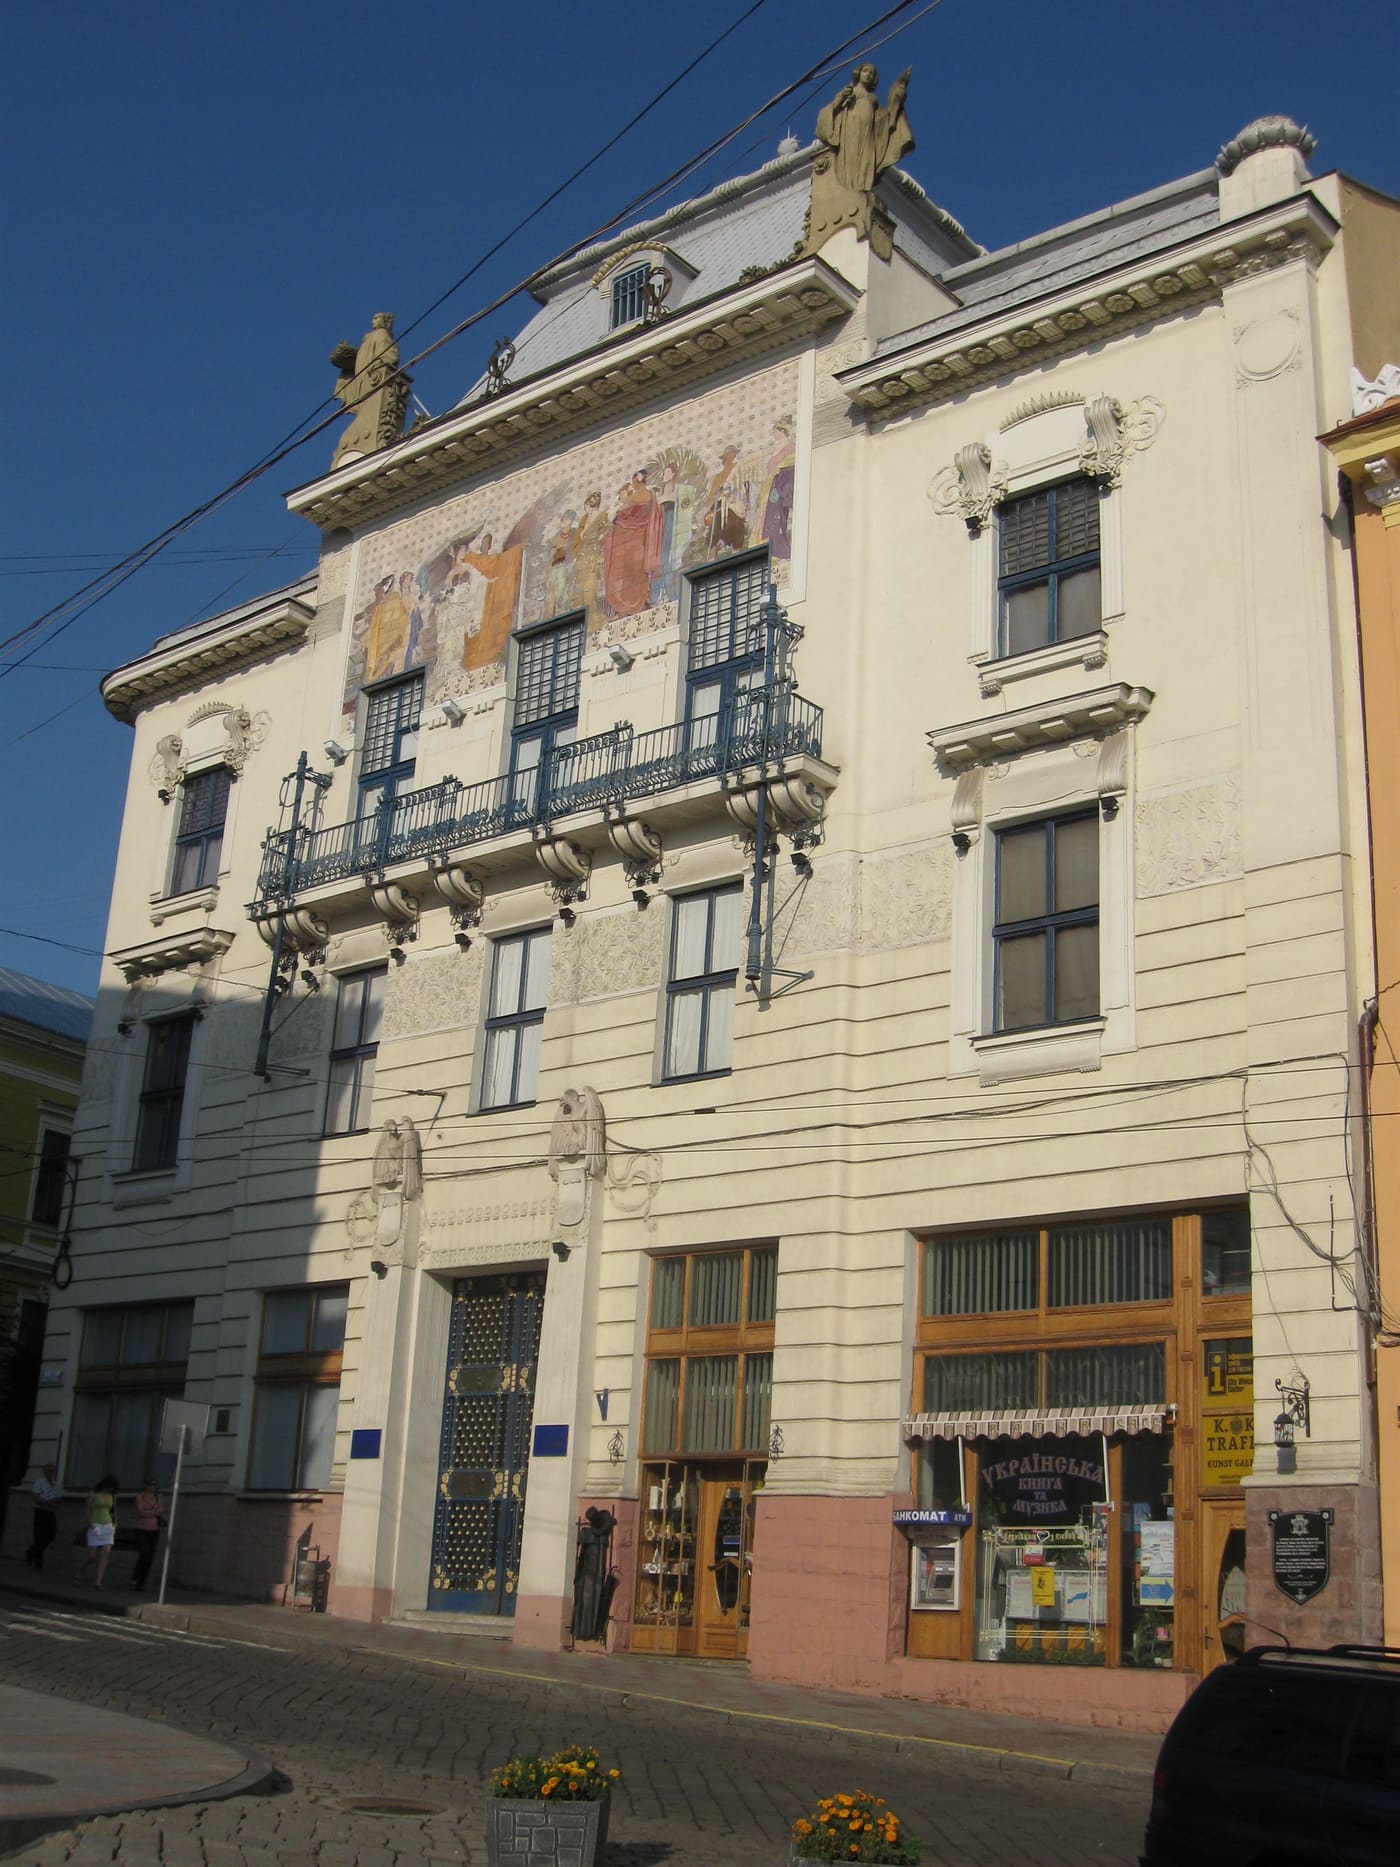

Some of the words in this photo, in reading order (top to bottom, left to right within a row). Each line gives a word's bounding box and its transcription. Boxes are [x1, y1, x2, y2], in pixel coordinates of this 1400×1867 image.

[1207, 1459, 1232, 1468] KUNST
[981, 1453, 1104, 1488] УКРАЇНСЬКА
[1018, 1477, 1063, 1490] КНИГА
[1033, 1491, 1048, 1500] ТА
[1012, 1500, 1068, 1517] МУЗИКА
[893, 1510, 947, 1521] БАНКОМАТ
